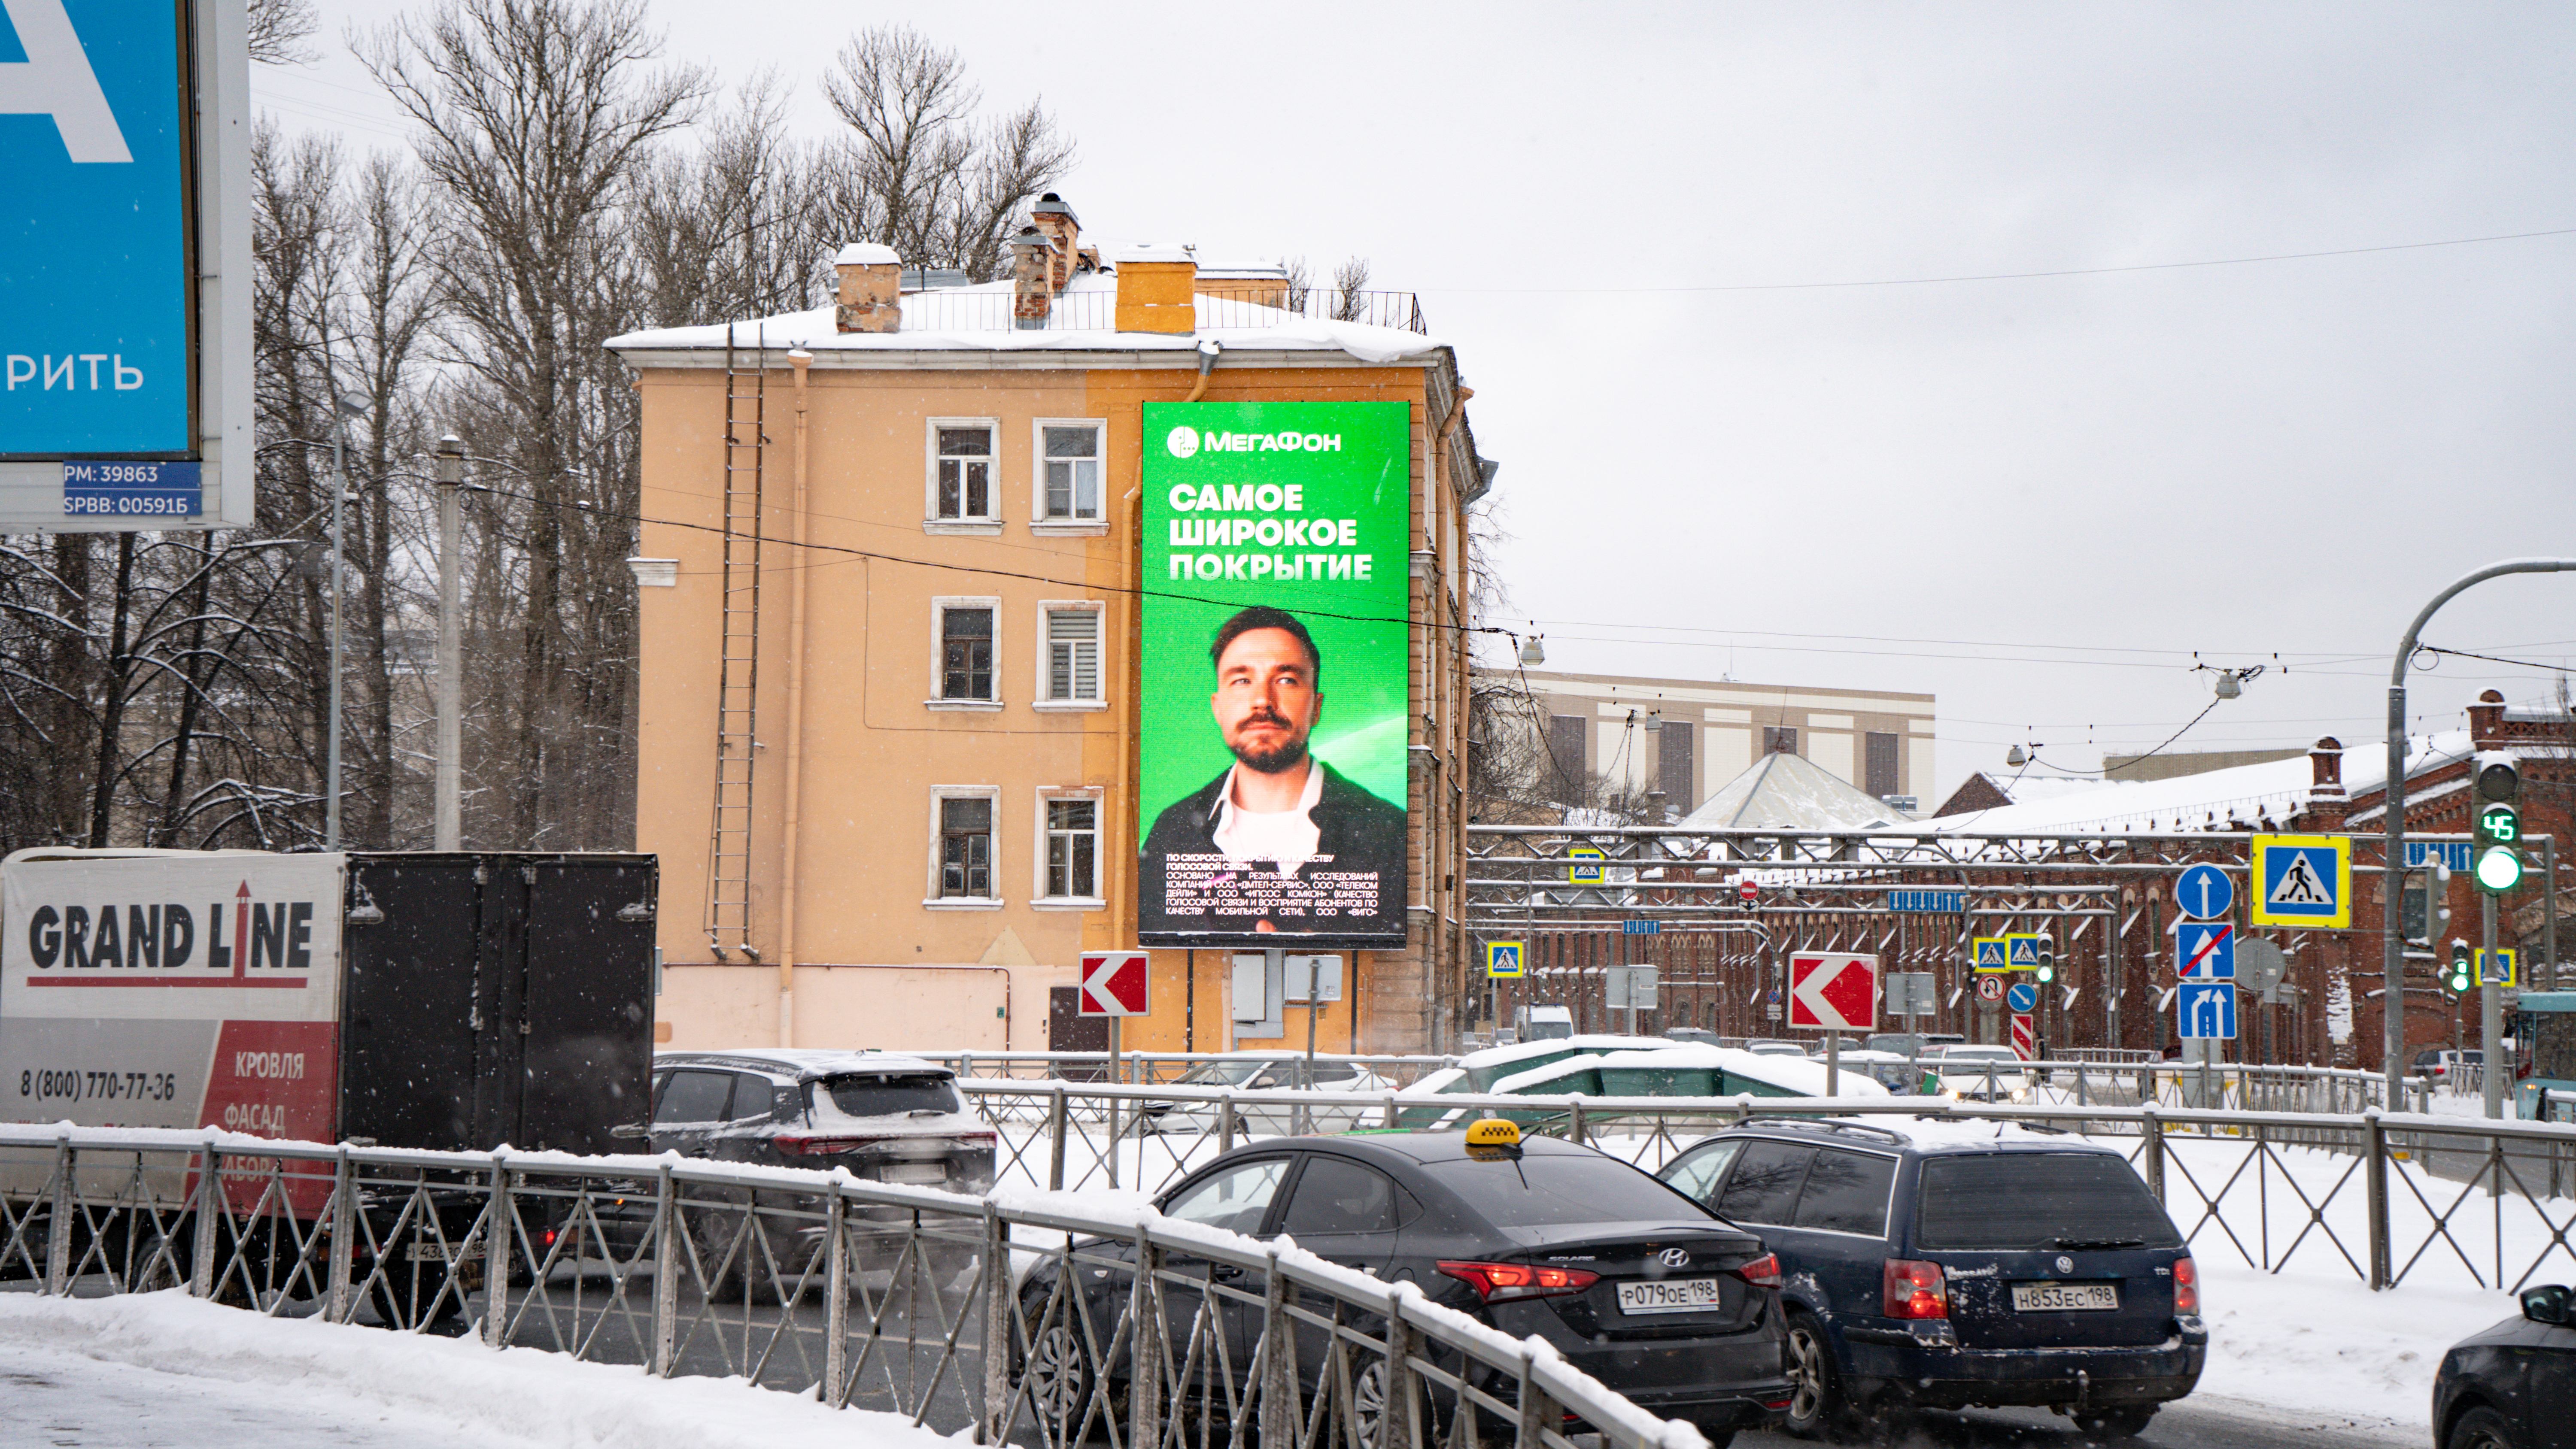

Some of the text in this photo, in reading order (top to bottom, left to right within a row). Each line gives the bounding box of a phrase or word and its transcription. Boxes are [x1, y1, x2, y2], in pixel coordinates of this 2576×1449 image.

[6, 354, 143, 391] РИТЬ
[100, 466, 158, 482] 39863
[118, 498, 188, 513] 00591Б
[1169, 484, 1303, 511] САМОЕ
[1170, 519, 1357, 546] ШИРОКОЕ
[1170, 554, 1372, 580] ПОКРЫТИЕ
[2484, 815, 2513, 840] 45
[1166, 854, 1180, 862] ПО
[1180, 854, 1231, 863] СКОРОСТИ,
[1166, 862, 1221, 870] ГОЛОСОВОЙ
[1166, 880, 1212, 888] КОМПАНИЙ
[1249, 872, 1299, 880] РЕЗУЛЬТАТАХ
[1310, 872, 1378, 881] ИССЛЕДОВАНИЙ
[1166, 888, 1197, 898] ДЕЙЛИ»
[1217, 889, 1238, 897] ООО
[1245, 890, 1281, 898] «ИПСОС
[1287, 890, 1327, 898] КОМКОН»
[1334, 889, 1378, 898] (КАЧЕСТВО
[1166, 897, 1219, 906] ГОЛОСОВОЙ
[1215, 906, 1268, 915] МОБИЛЬНОЙ
[1279, 907, 1305, 916] СЕТИ),
[30, 902, 313, 977] GRAND LINE
[235, 1052, 304, 1079] КРОВЛЯ
[21, 1069, 175, 1103] 8 (800) 770-77-36
[225, 1103, 286, 1137] ФАСАД
[222, 1155, 269, 1182] АБОР
[1690, 1281, 1712, 1296] 198
[2087, 1288, 2112, 1301] 198
